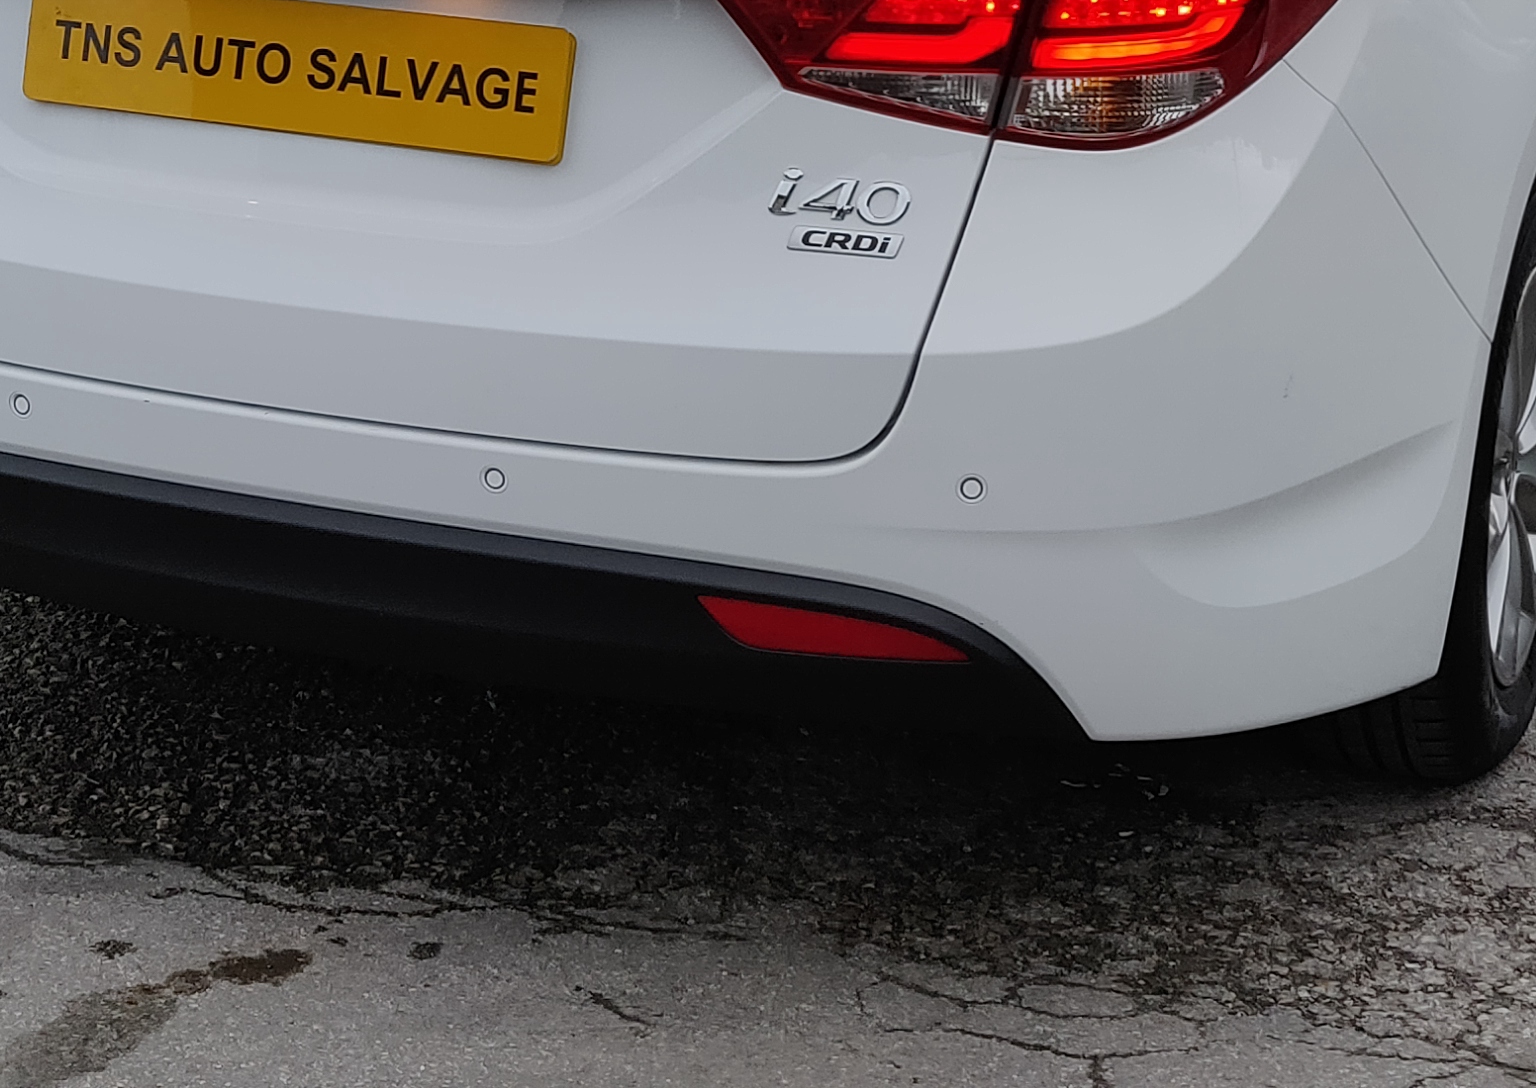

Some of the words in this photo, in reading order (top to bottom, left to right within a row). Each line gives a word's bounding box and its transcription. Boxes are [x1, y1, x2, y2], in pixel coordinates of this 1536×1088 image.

[55, 19, 142, 67] TNS
[155, 32, 292, 84] AUTO
[306, 48, 539, 113] SALVAGE
[767, 167, 912, 226] i40
[801, 229, 892, 254] CRDi
